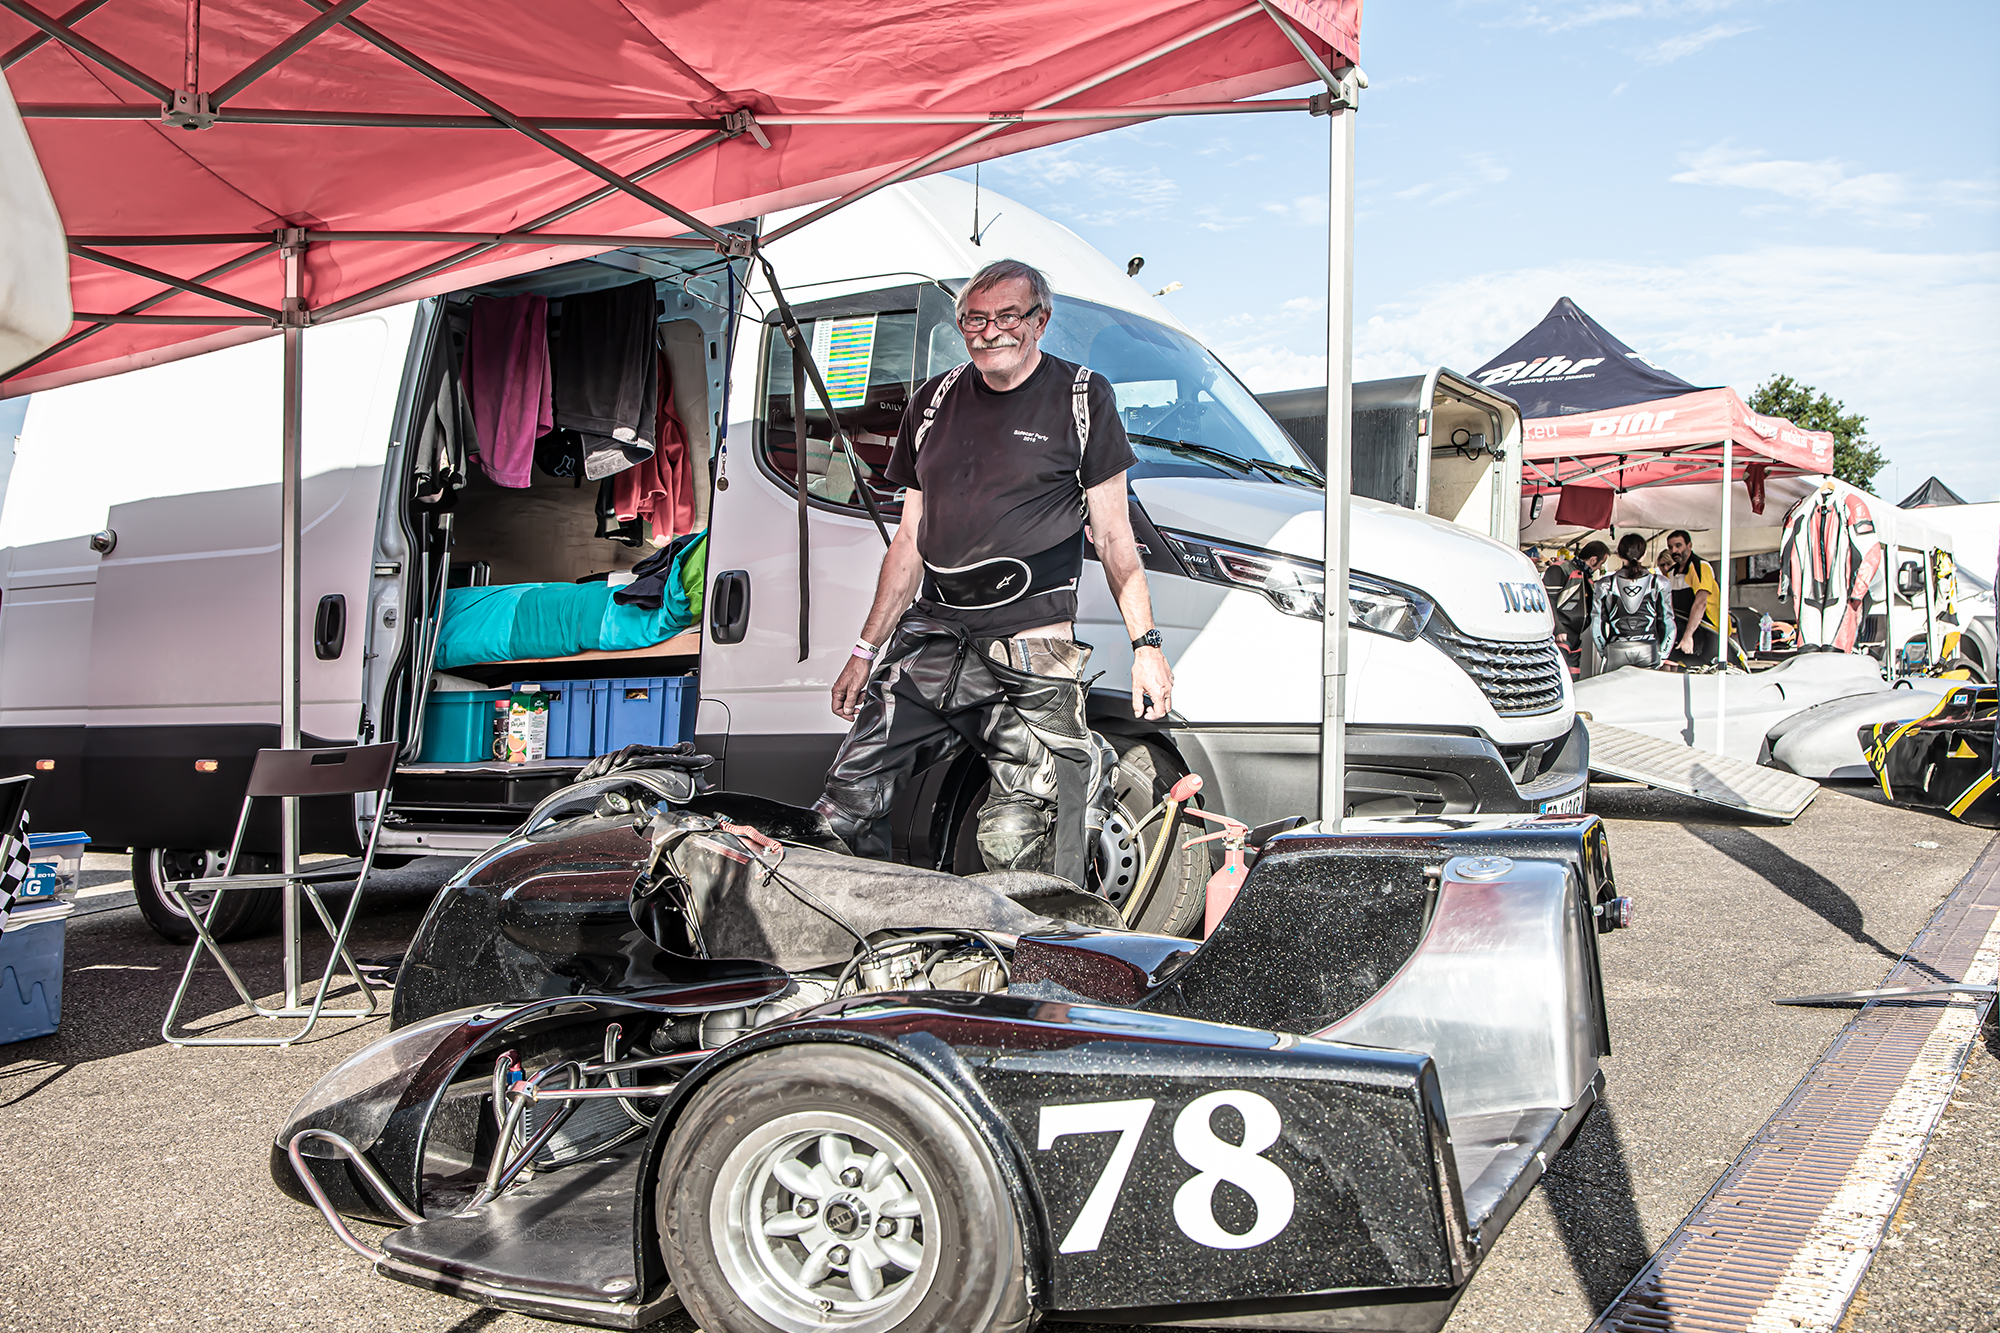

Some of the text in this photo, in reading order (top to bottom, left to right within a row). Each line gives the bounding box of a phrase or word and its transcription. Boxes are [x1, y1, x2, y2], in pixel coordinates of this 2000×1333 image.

[880, 401, 903, 412] DAILY
[1523, 424, 1560, 440] r.eu
[1183, 553, 1209, 564] DAILY
[1496, 582, 1546, 613] IVECO
[1038, 1089, 1295, 1255] 78
[829, 1210, 855, 1229] MINI
